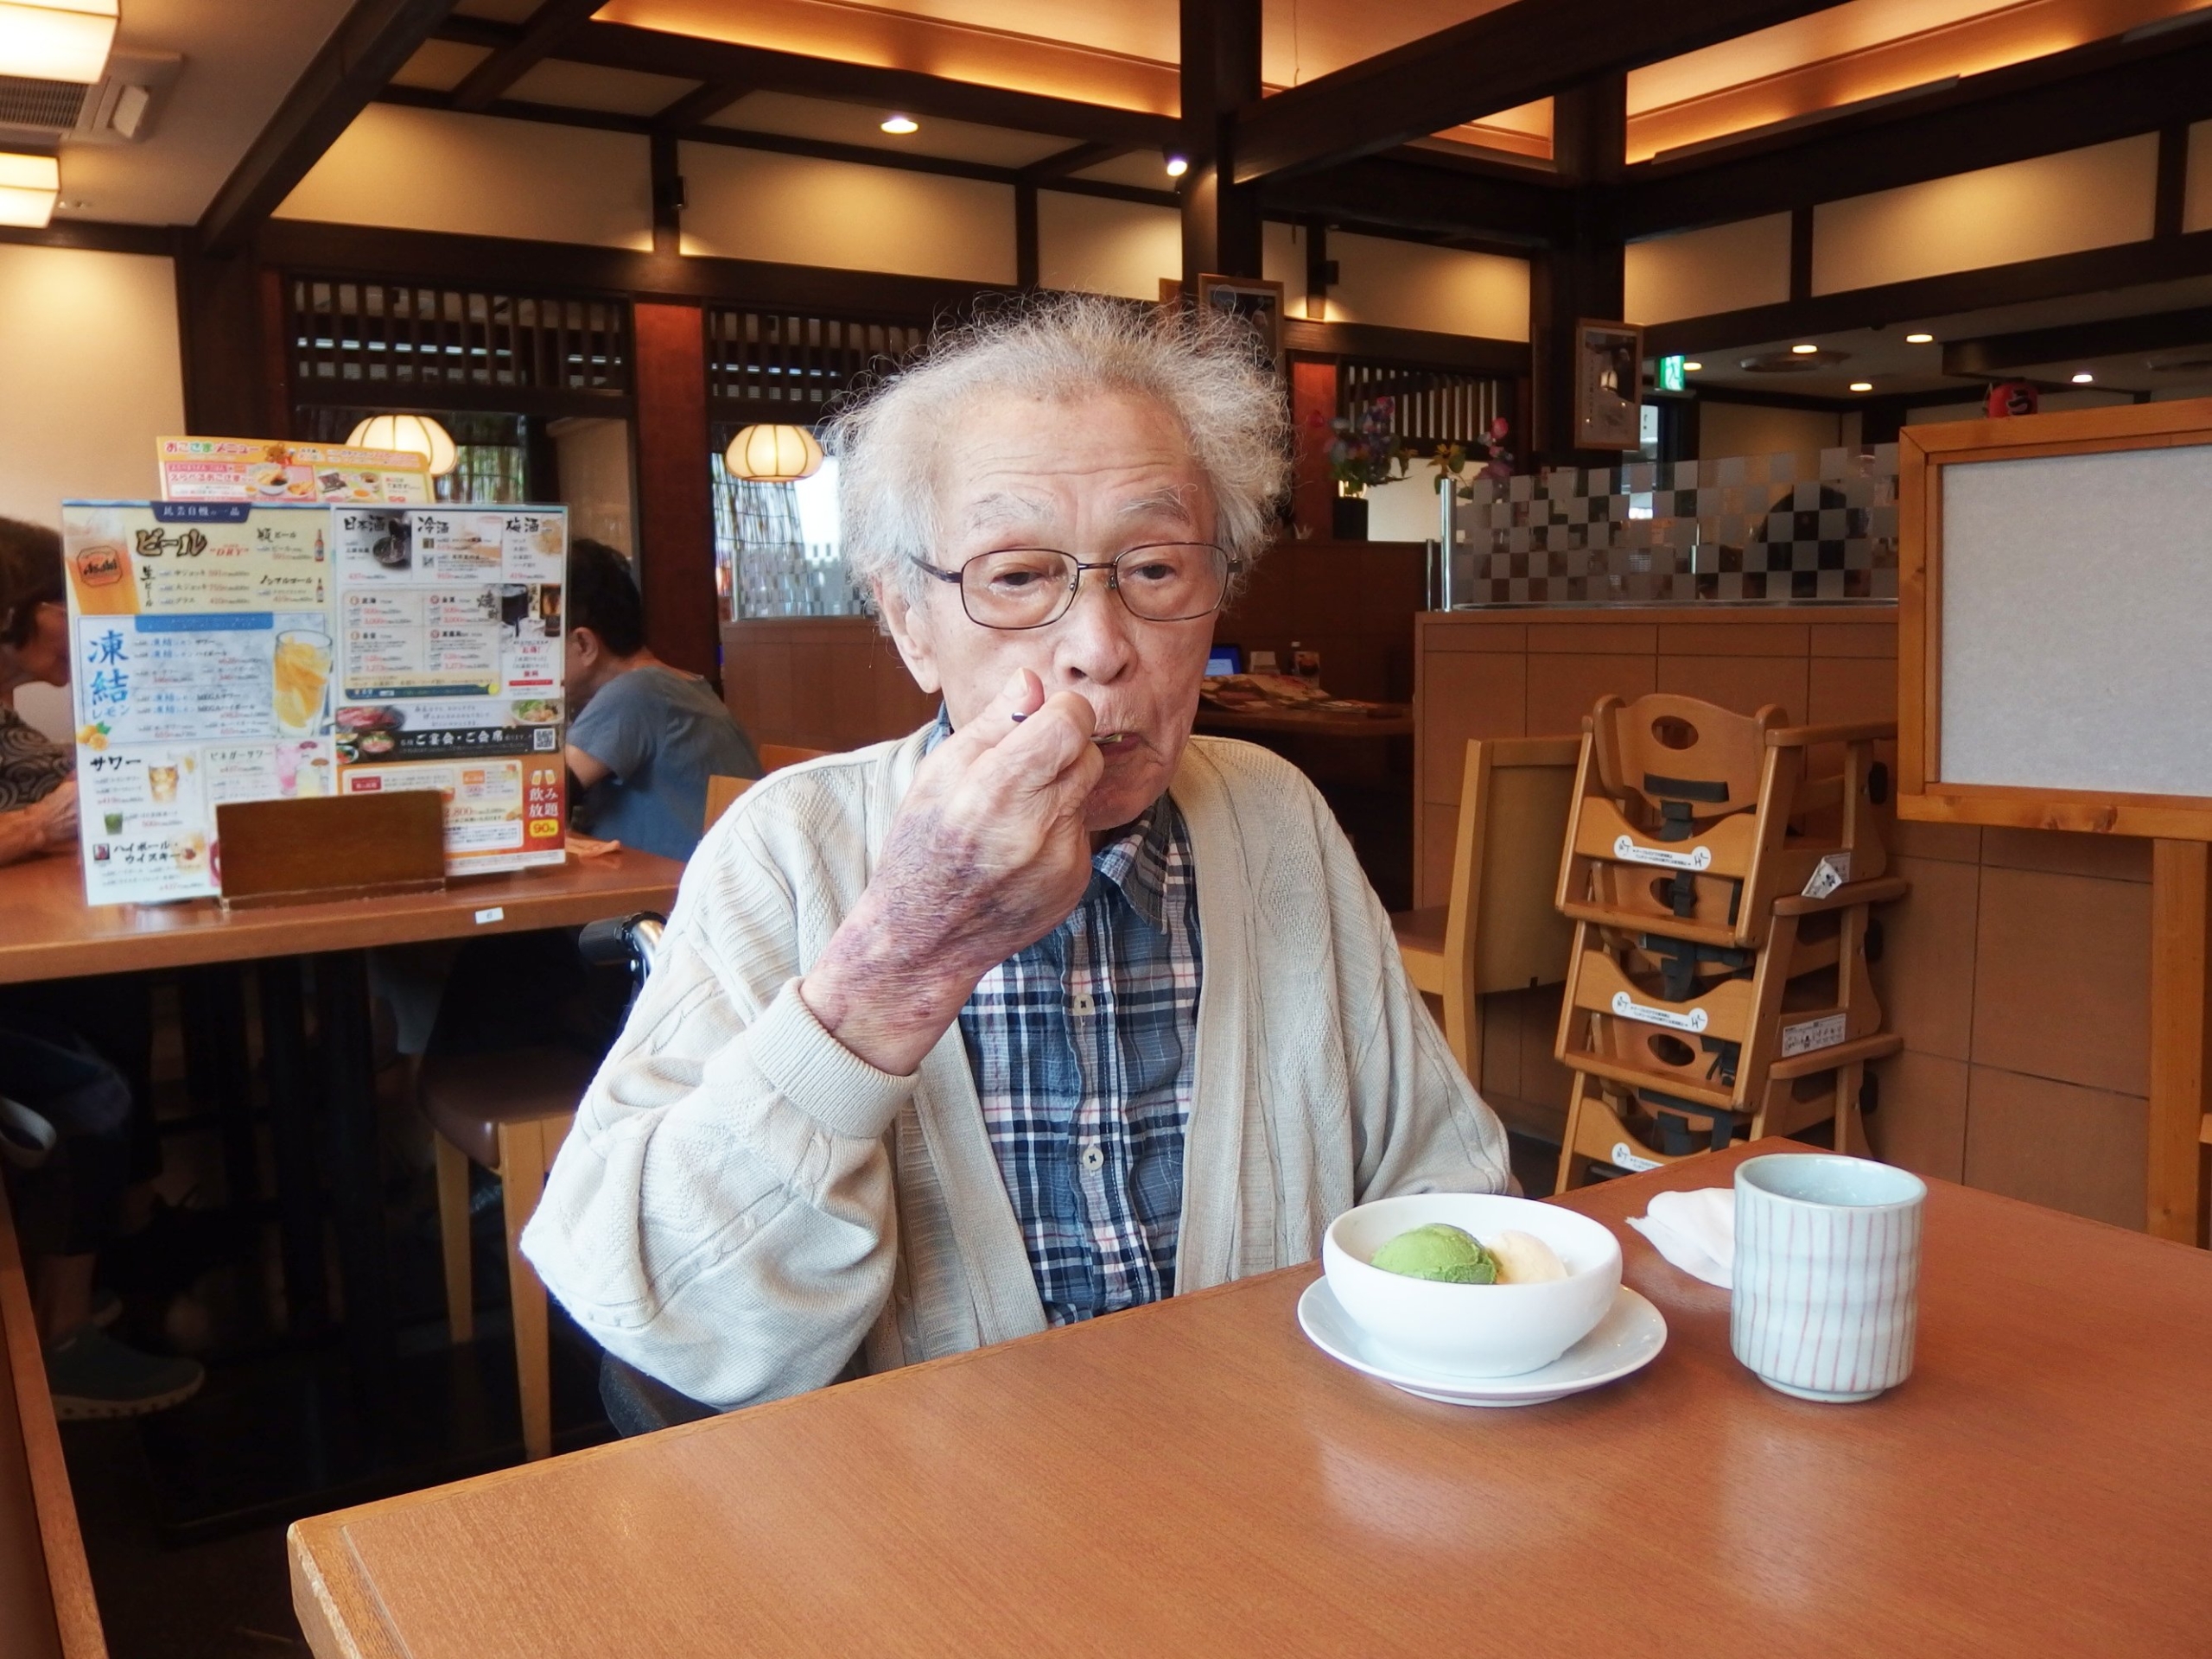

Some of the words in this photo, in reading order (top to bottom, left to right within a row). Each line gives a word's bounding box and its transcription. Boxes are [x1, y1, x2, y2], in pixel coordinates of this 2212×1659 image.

[166, 442, 259, 454] おこさまメニュー
[344, 514, 385, 532] 日本酒
[417, 516, 448, 534] 冷酒
[505, 517, 539, 533] 梅酒
[135, 527, 207, 557] ビール
[83, 559, 118, 575] Asahi
[260, 575, 313, 586] ノンアルコール
[92, 704, 130, 720] レモン
[90, 754, 142, 772] サワー
[529, 786, 559, 802] 飲み
[529, 802, 559, 818] 放題
